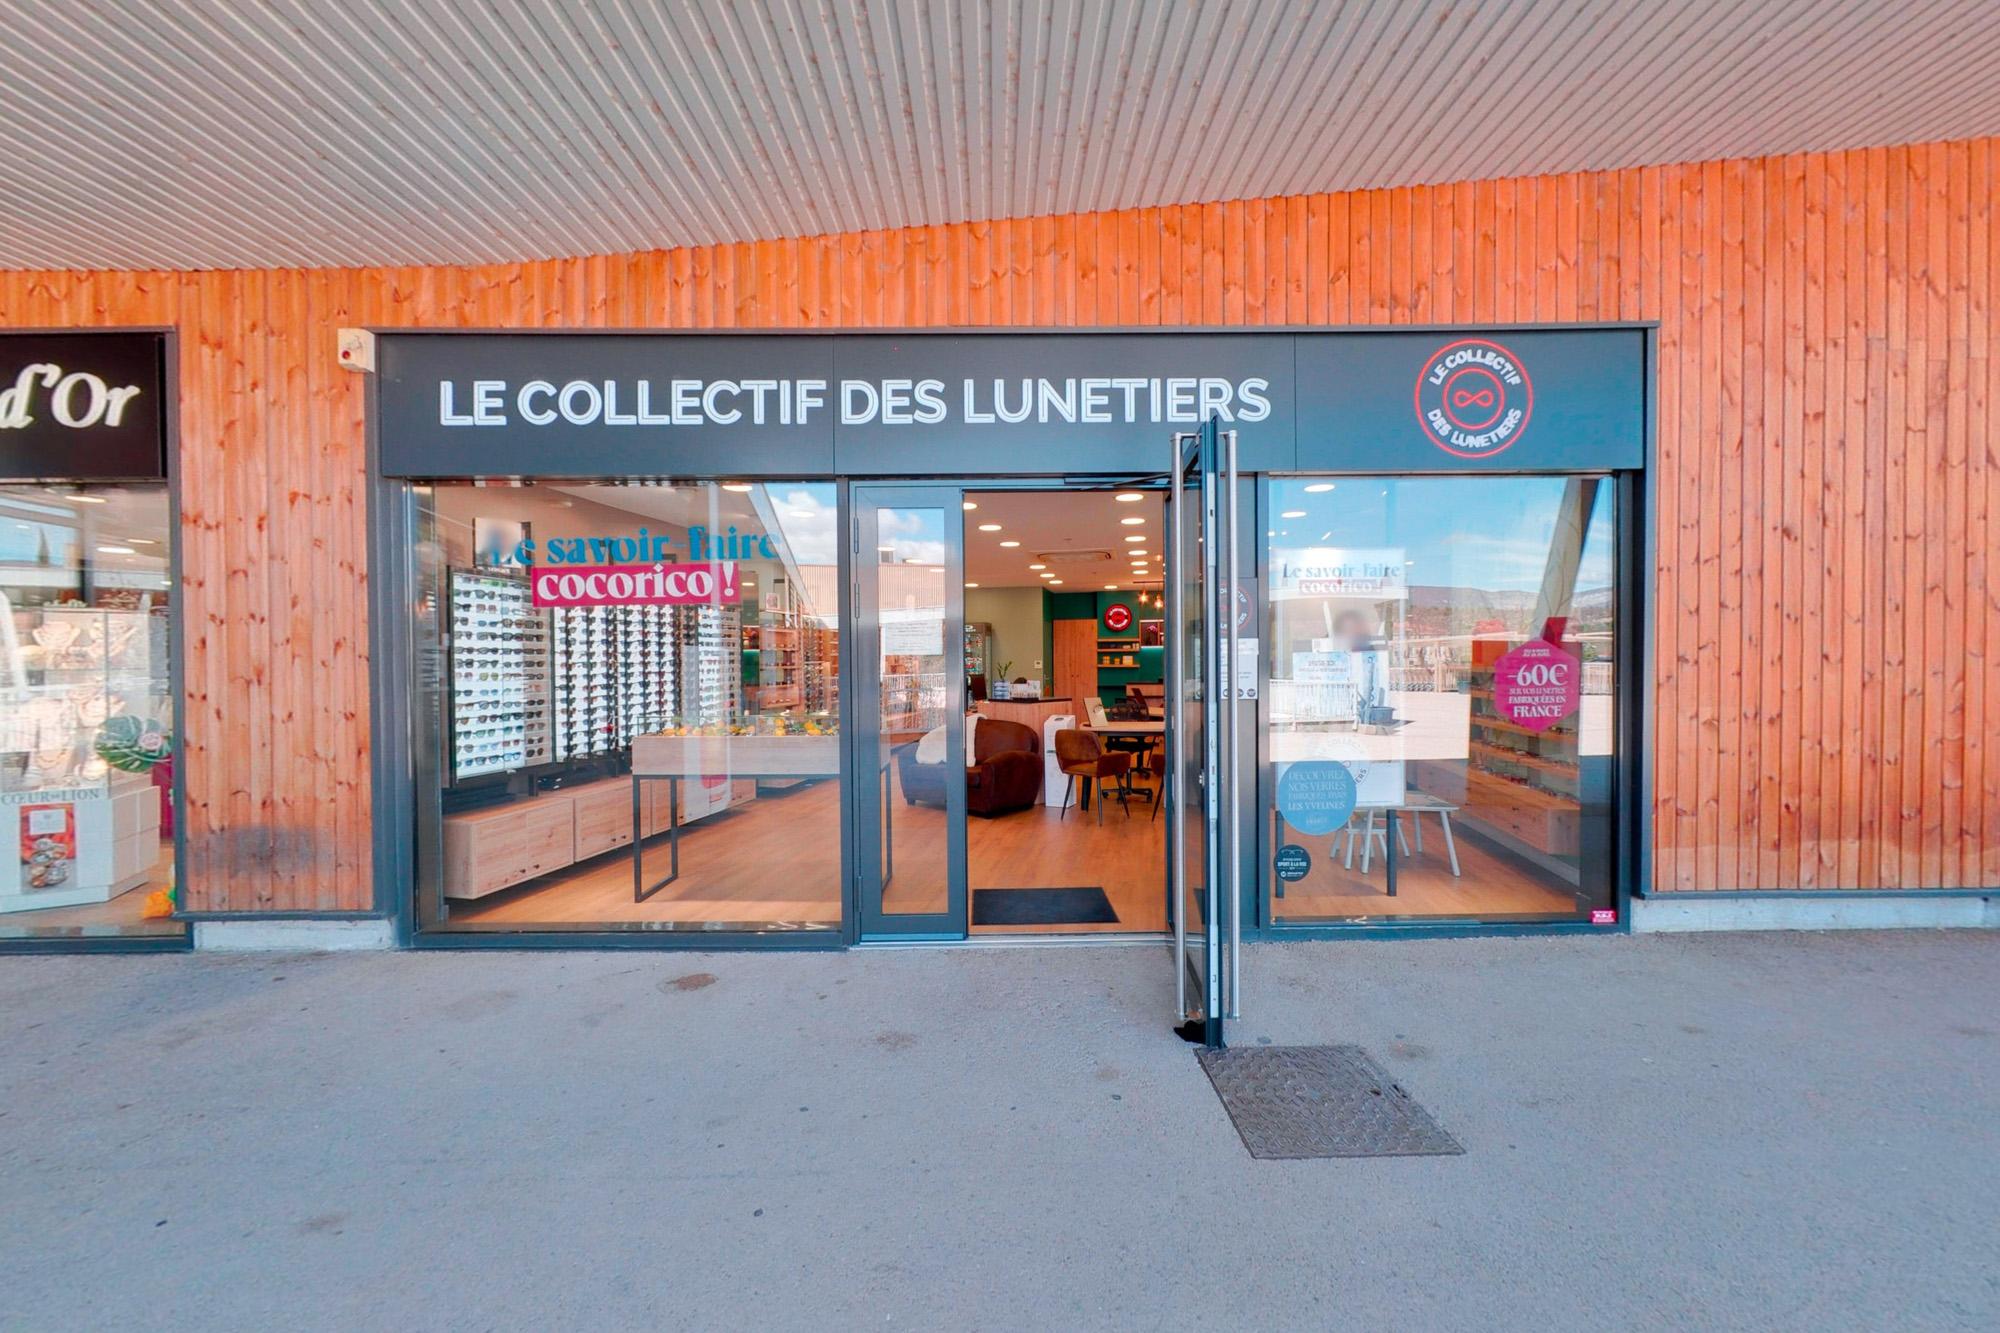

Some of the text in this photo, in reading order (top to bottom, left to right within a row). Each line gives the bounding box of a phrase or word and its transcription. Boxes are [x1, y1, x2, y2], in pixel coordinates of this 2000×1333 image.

[1429, 349, 1522, 385] LE COLLECTIF
[440, 377, 1272, 426] LE COLLECTIF DES LUNETIERS
[1427, 408, 1522, 448] DES LUNETIERS
[537, 563, 714, 601] cocorico
[1507, 664, 1568, 687] -60€
[1513, 705, 1562, 717] FRANCE
[1310, 781, 1346, 791] VERRES
